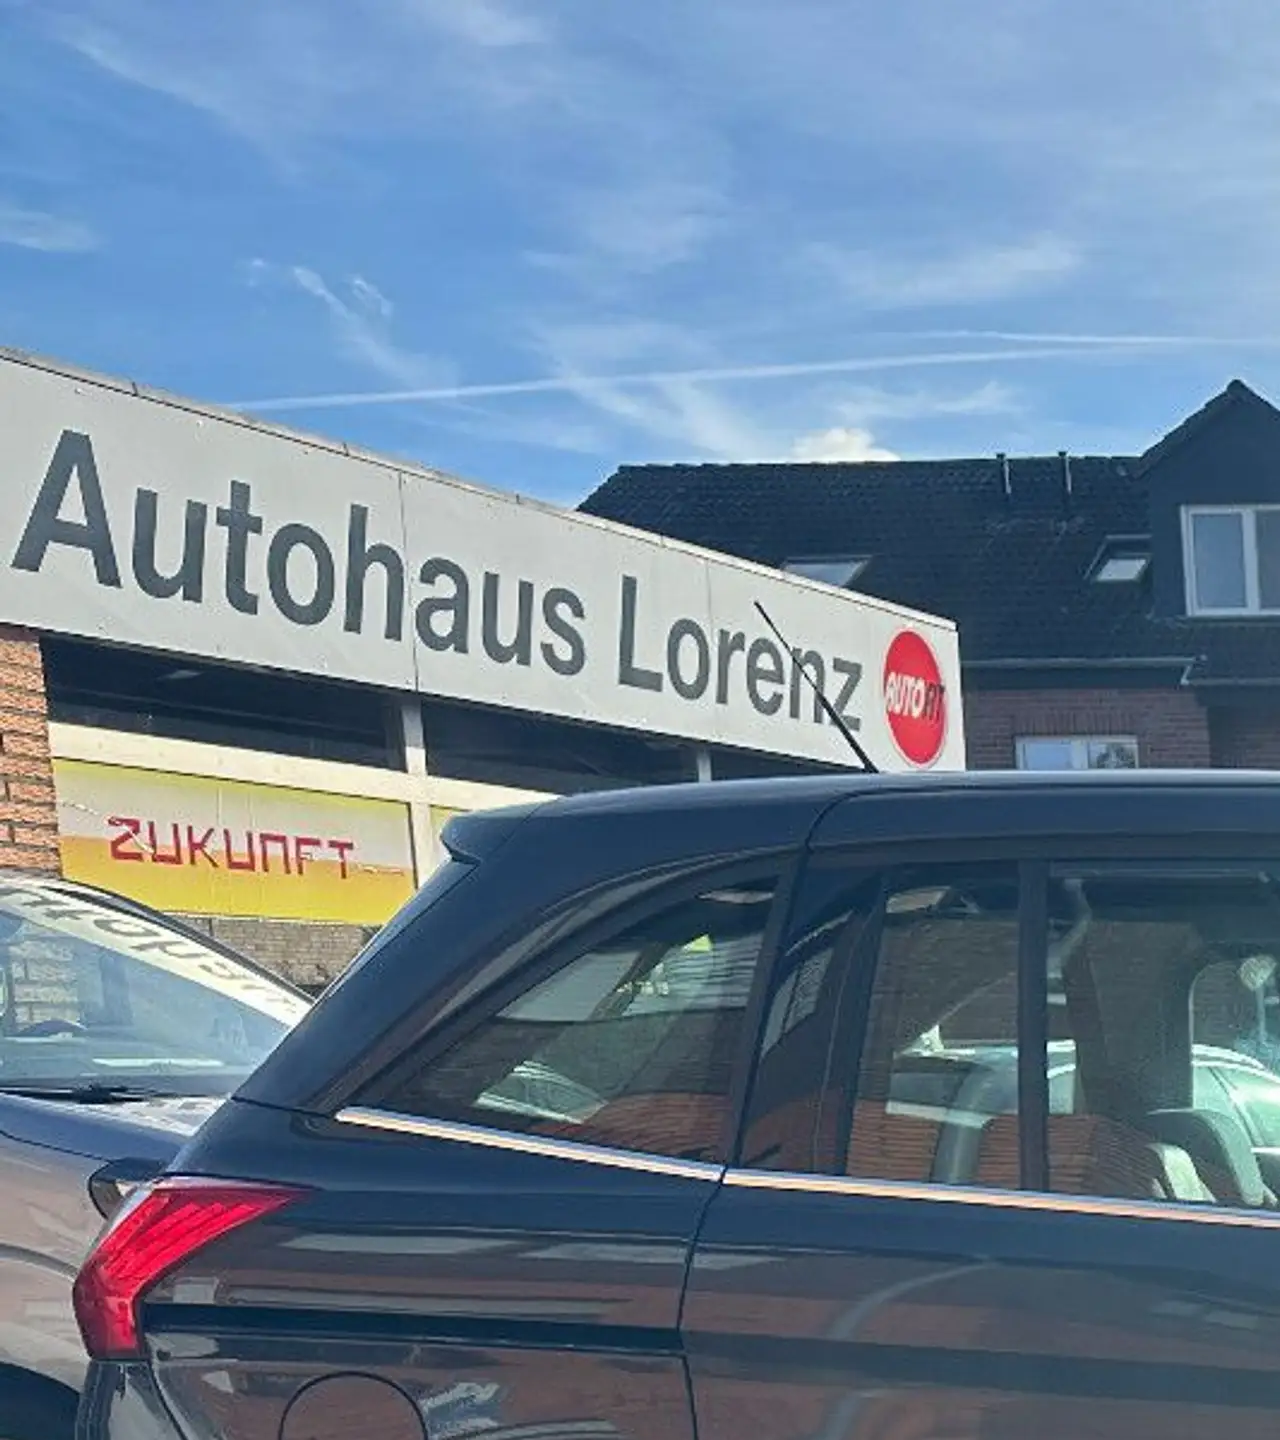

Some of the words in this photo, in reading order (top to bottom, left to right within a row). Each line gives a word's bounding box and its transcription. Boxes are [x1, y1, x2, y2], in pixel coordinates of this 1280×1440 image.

[11, 429, 586, 676] Autohaus
[619, 576, 863, 731] Lorenz
[107, 815, 354, 880] ZUKUNFT
